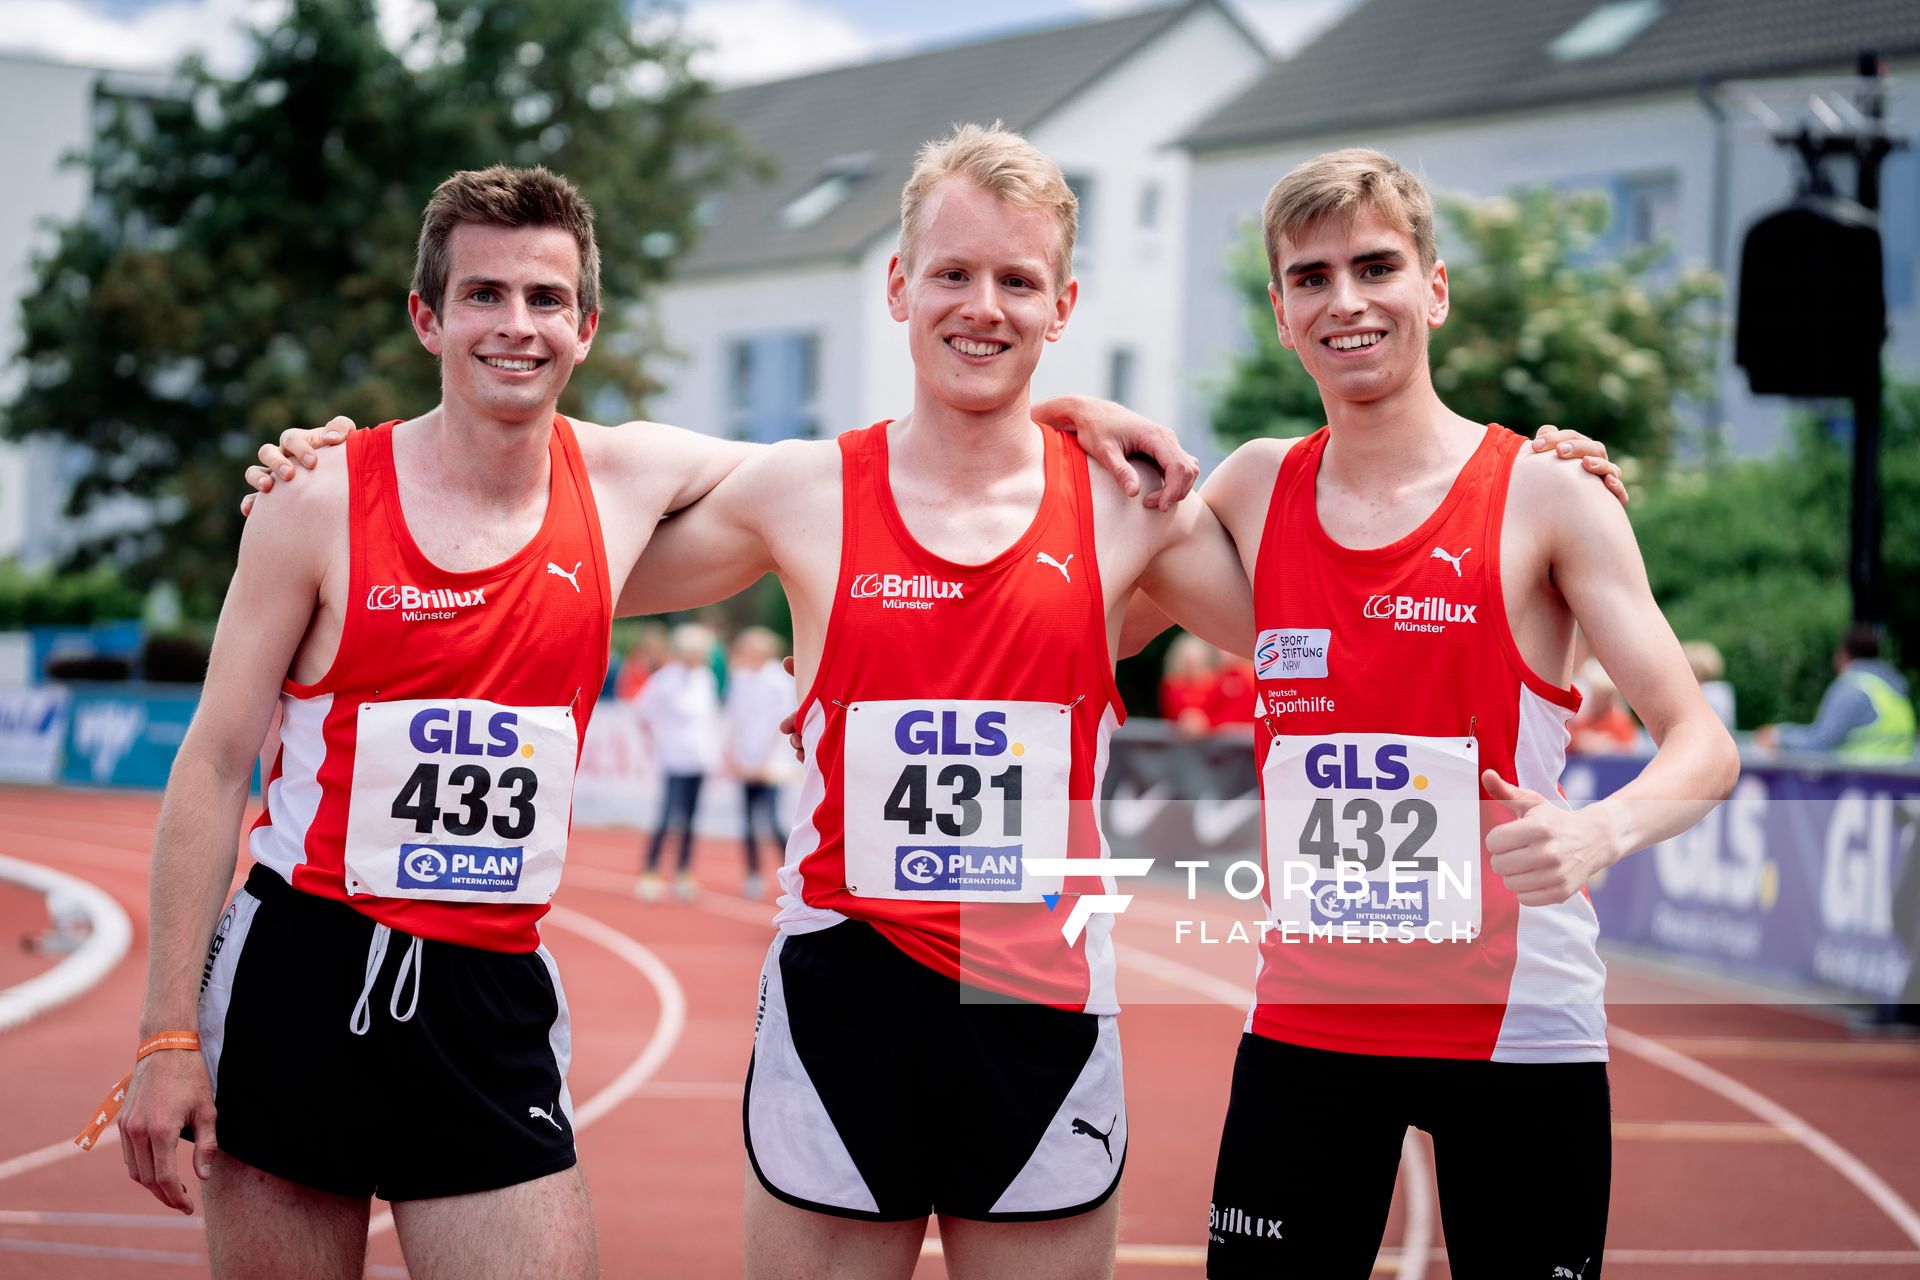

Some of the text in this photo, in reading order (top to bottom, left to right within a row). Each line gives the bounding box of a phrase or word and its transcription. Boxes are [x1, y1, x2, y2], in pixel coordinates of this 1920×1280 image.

[882, 574, 964, 599] Brillux
[401, 586, 486, 610] Brillux
[882, 599, 934, 610] Münster
[402, 610, 457, 622] Münster
[1395, 596, 1477, 624] Brillux
[1394, 622, 1446, 634] Münster
[1280, 635, 1309, 647] SPORT
[1282, 647, 1323, 659] STIFTUNG
[1282, 660, 1301, 671] NRW
[1269, 696, 1335, 718] Sporthilfe
[391, 763, 538, 839] 433
[883, 764, 1025, 837] 431
[1299, 799, 1438, 873] 432
[452, 853, 518, 876] PLAN
[948, 854, 1017, 875] PLAN
[452, 877, 514, 887] INTERNATIONAL
[948, 877, 1017, 886] INTERNATIONAL
[1355, 889, 1423, 911] PLAN
[1355, 912, 1423, 921] INTERNATIONAL
[199, 934, 225, 1003] Brill
